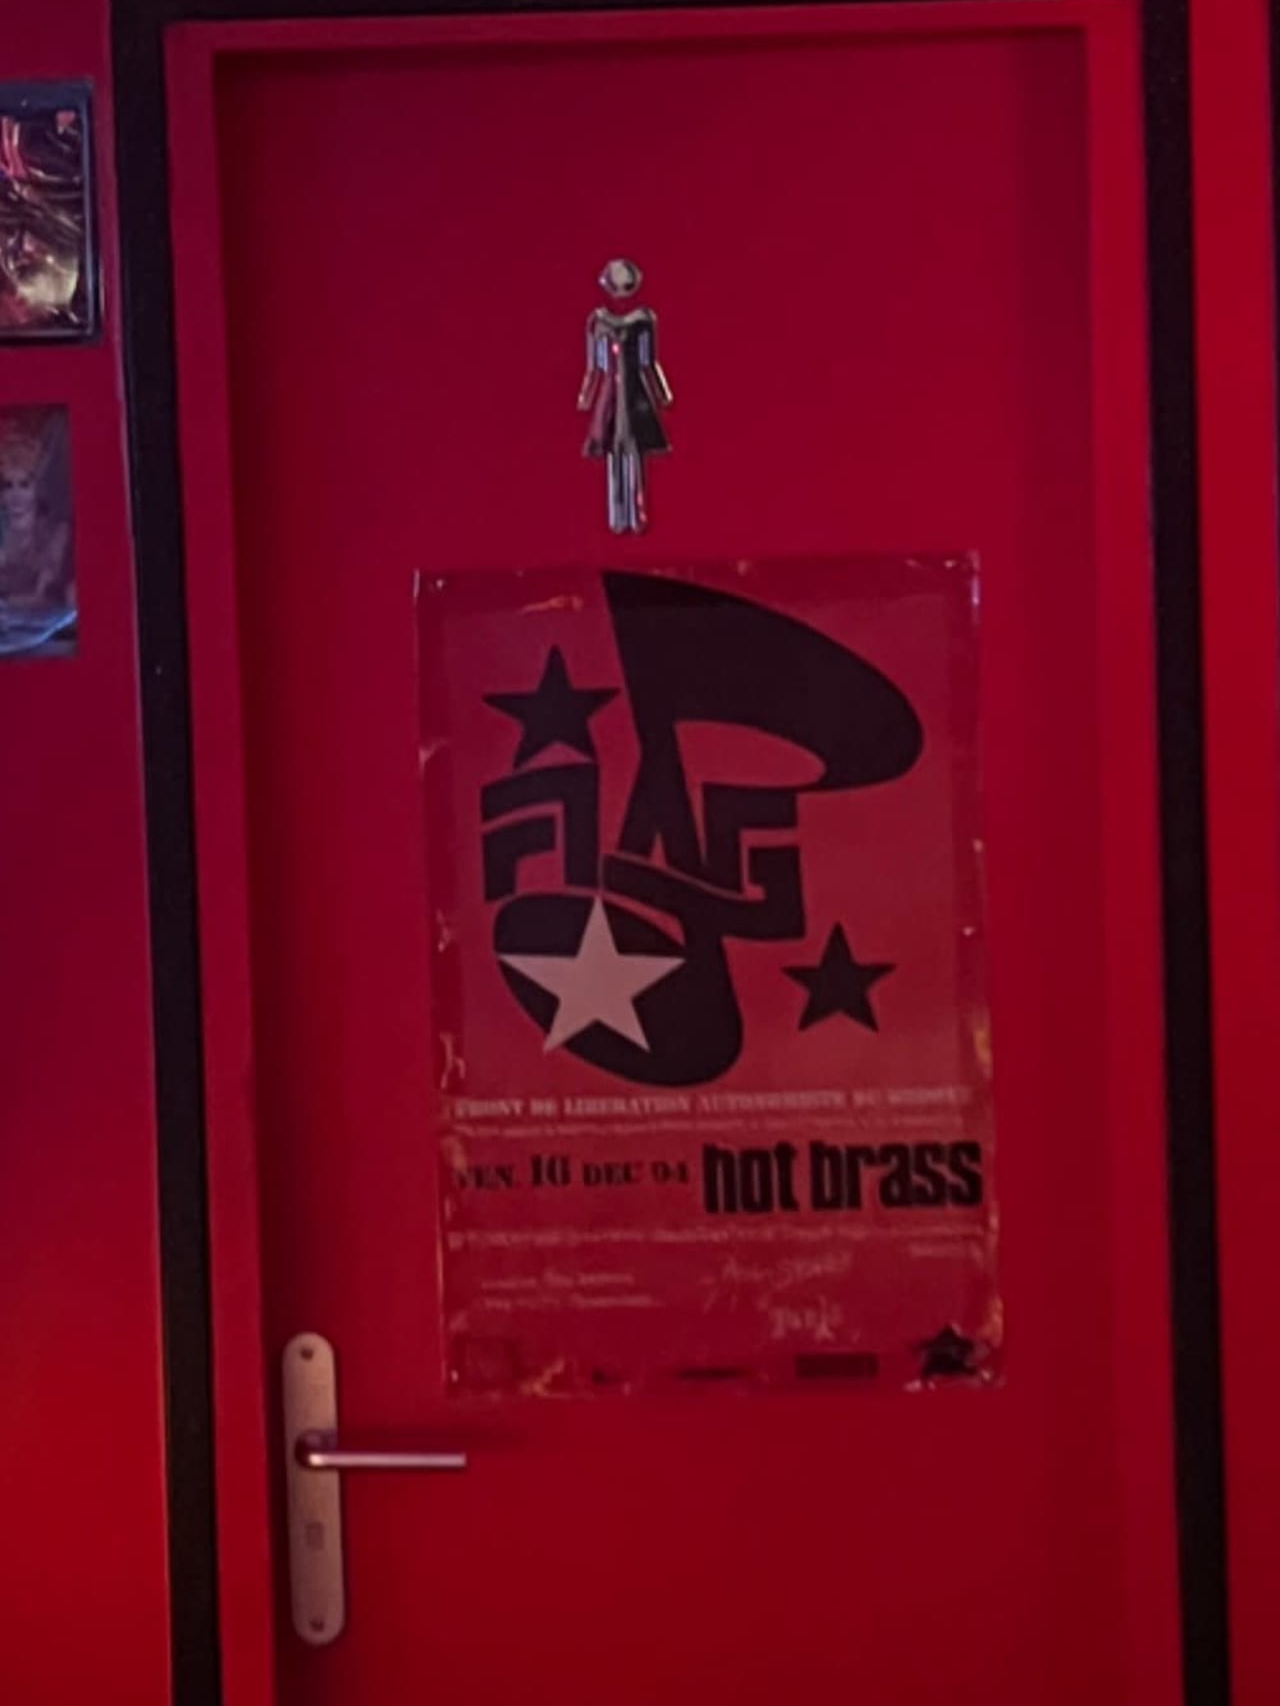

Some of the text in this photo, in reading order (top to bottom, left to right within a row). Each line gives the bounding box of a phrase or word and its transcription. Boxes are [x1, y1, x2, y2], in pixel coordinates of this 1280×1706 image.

[531, 1154, 571, 1186] 16
[702, 1140, 799, 1214] hot
[809, 1140, 983, 1212] brass
